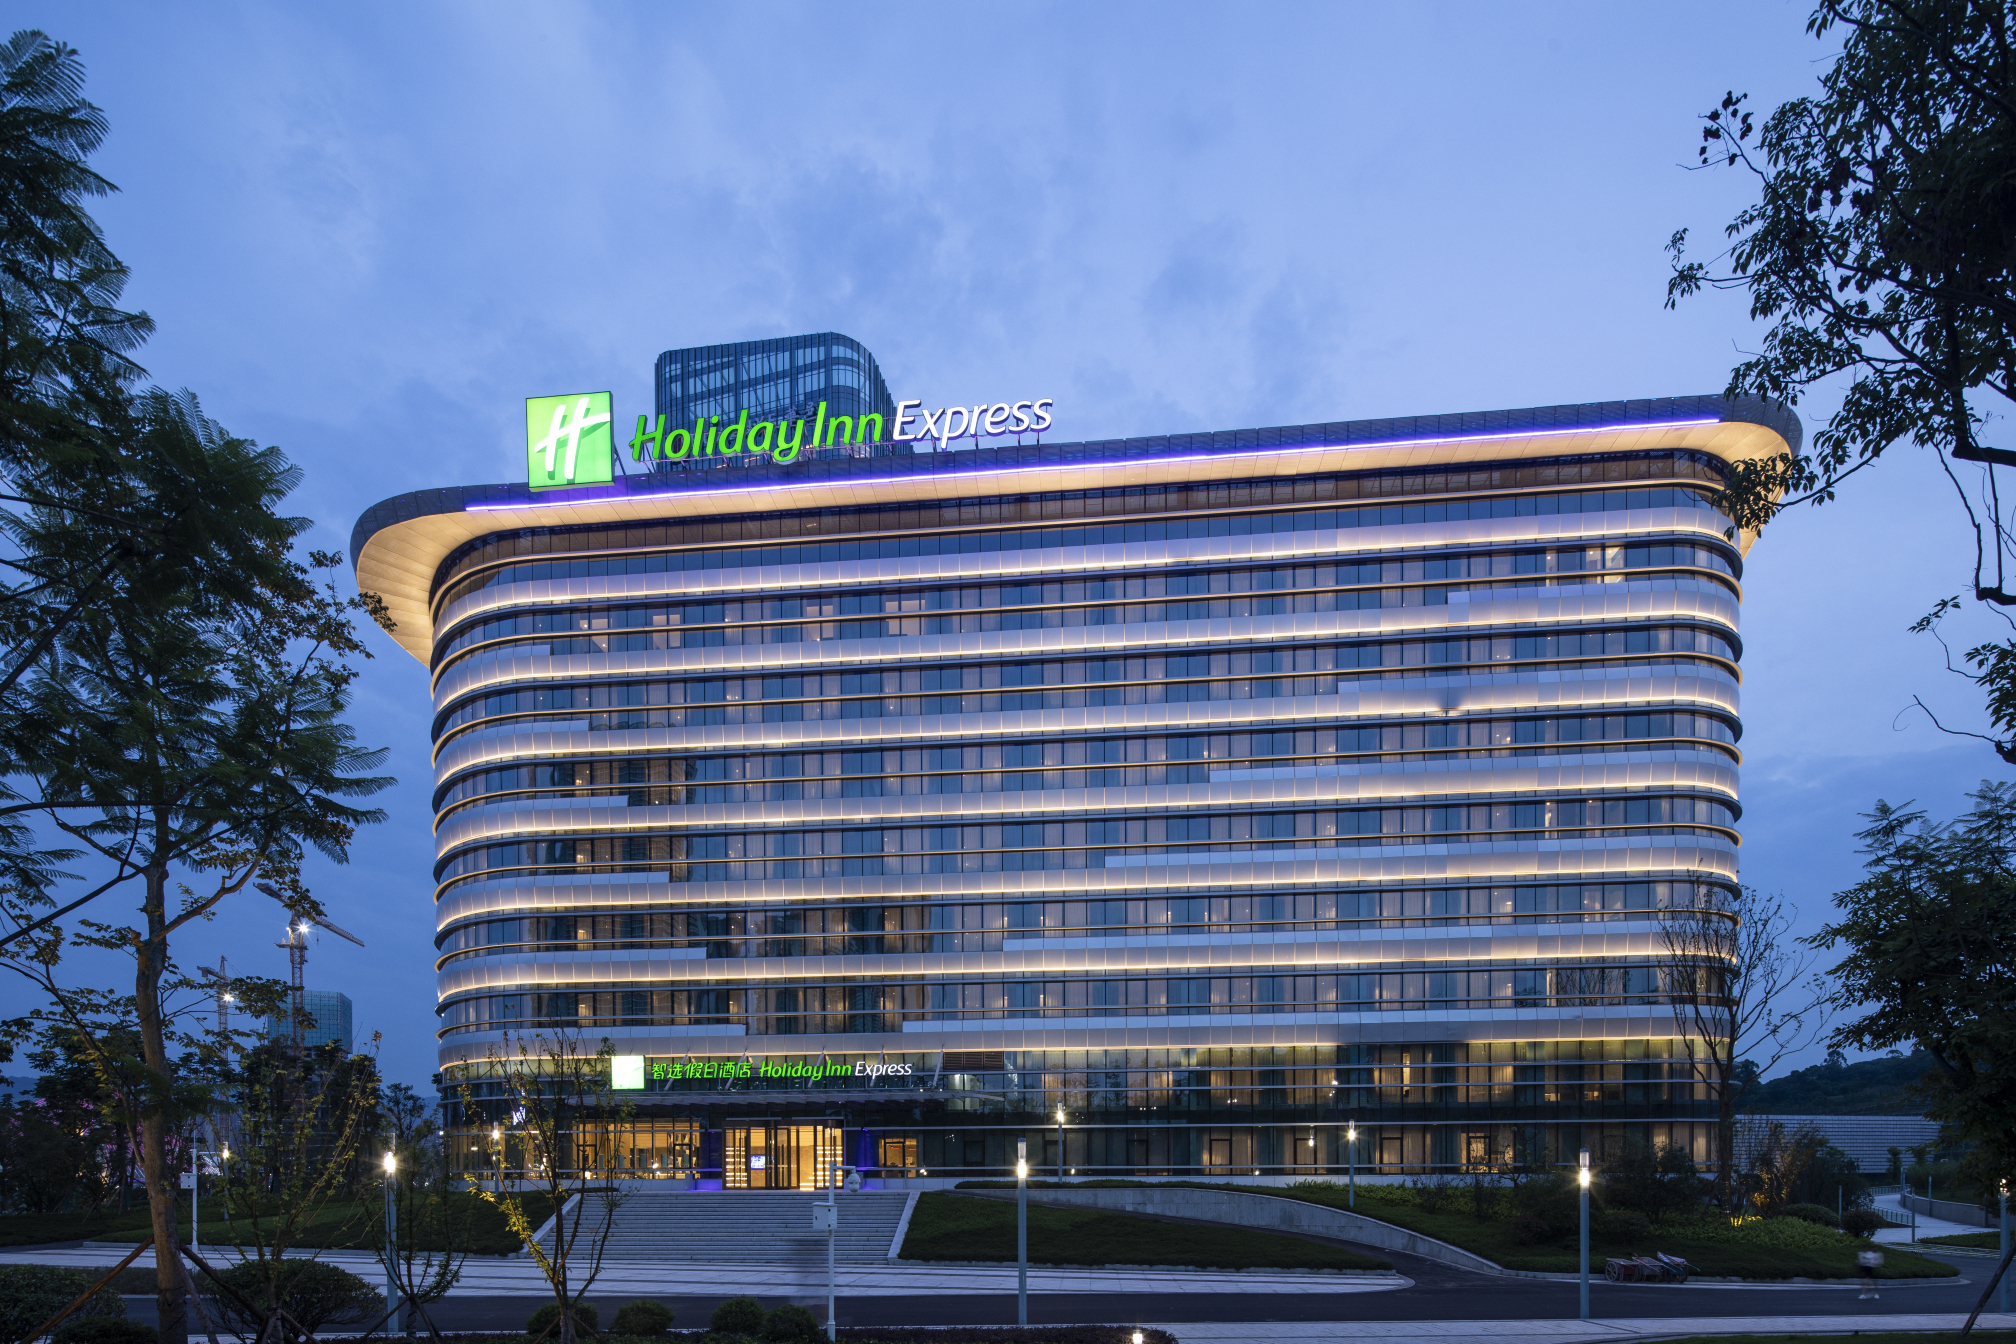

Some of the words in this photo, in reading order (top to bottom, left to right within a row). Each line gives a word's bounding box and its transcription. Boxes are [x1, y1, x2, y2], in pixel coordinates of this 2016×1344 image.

[892, 399, 1053, 449] Express
[651, 1061, 753, 1080] 智选假日酒店
[854, 1060, 912, 1081] Express
